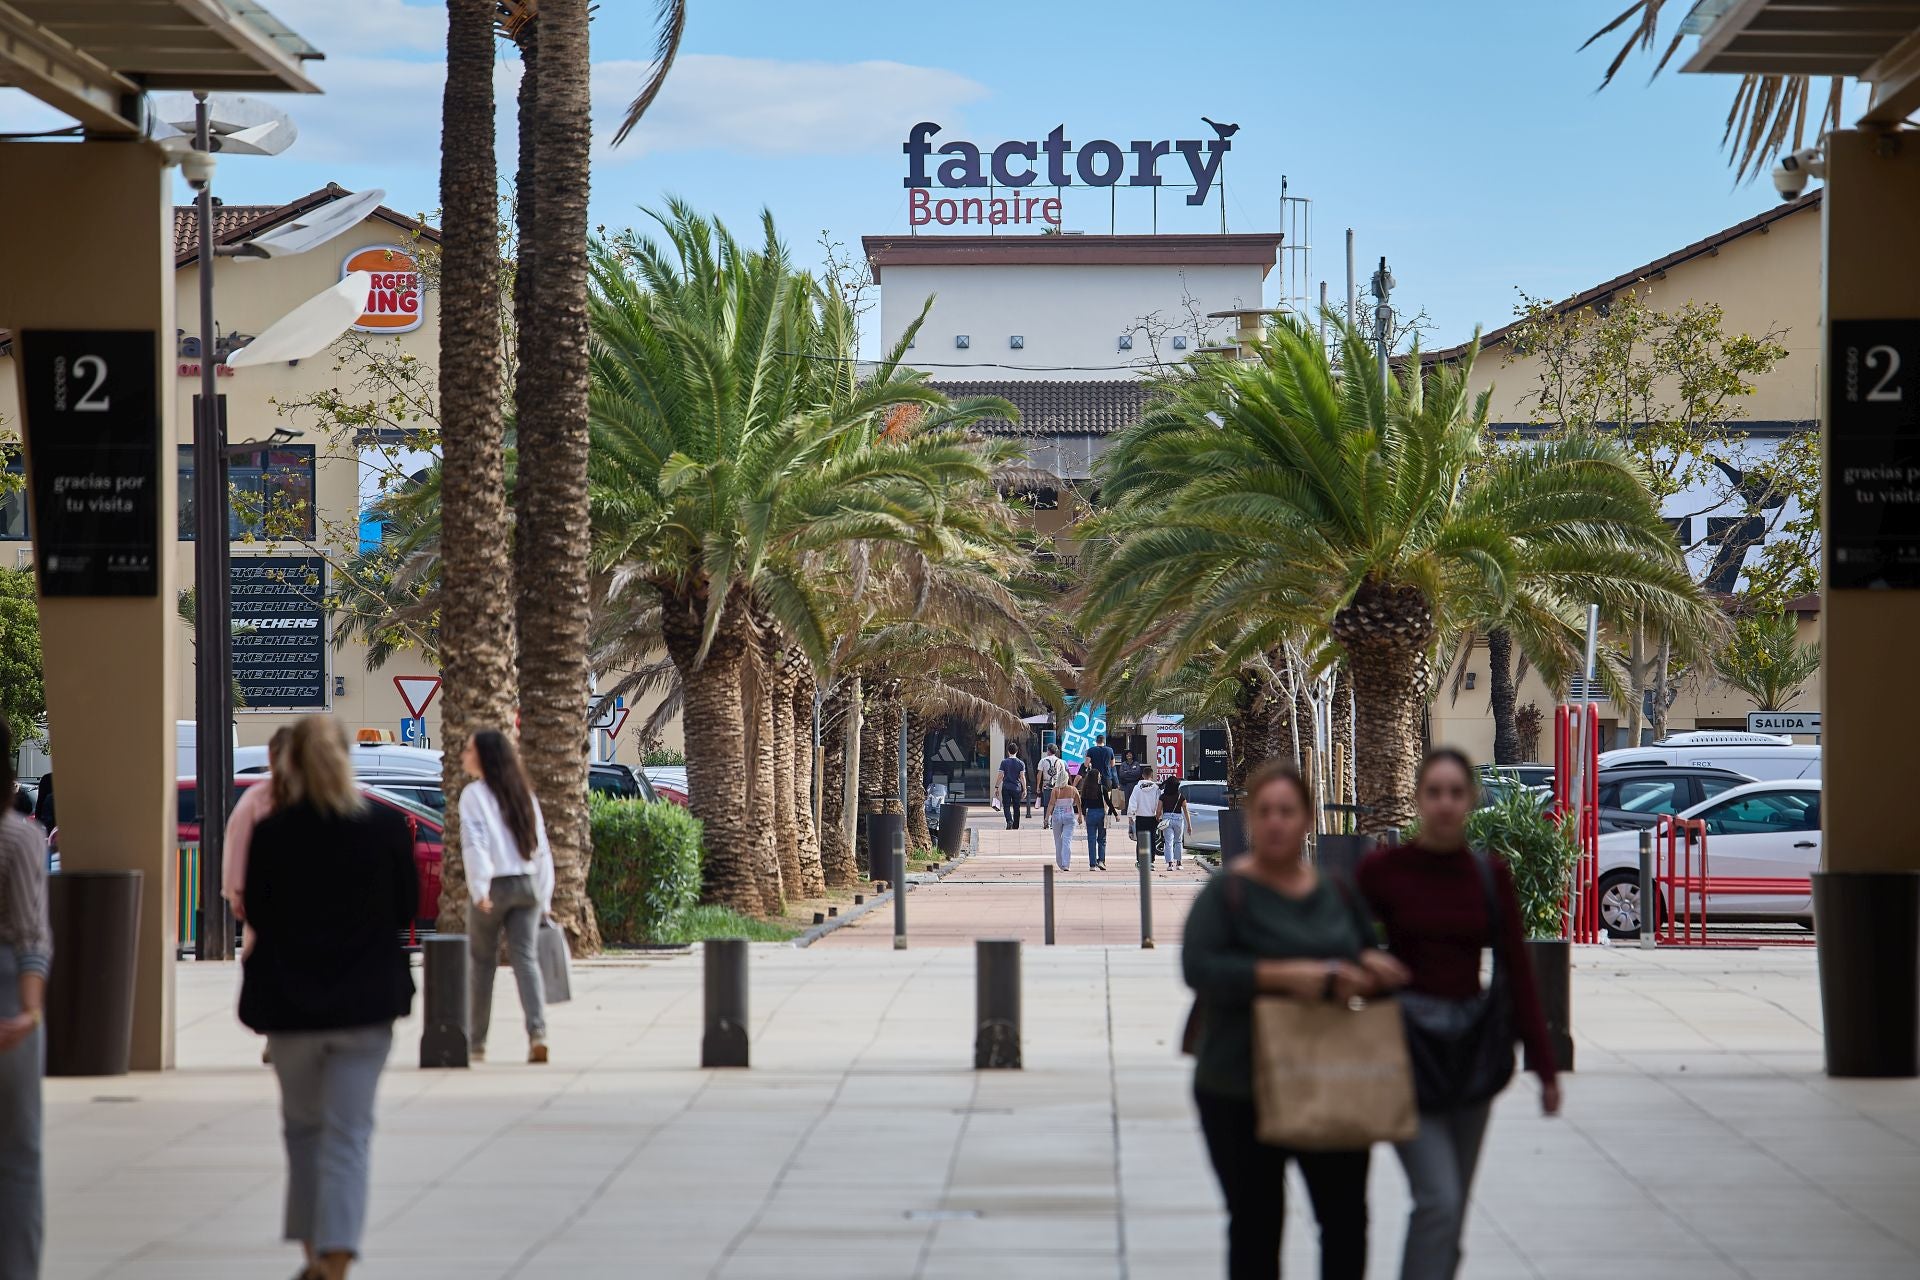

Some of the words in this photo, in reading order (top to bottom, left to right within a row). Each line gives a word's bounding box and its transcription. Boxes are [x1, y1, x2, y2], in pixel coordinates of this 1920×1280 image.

[903, 121, 1232, 206] factory
[909, 188, 1063, 226] Bonaire
[371, 273, 418, 290] RGER
[365, 290, 419, 313] ING
[72, 354, 111, 412] 2
[1865, 344, 1903, 402] 2
[54, 473, 111, 494] gracias
[115, 476, 146, 494] por
[1843, 463, 1903, 485] gracias
[66, 497, 84, 513] tu
[88, 496, 134, 513] visita
[1856, 488, 1874, 504] tu
[241, 686, 319, 697] KECHERS
[1755, 718, 1805, 729] SALIDA
[1205, 748, 1228, 756] Bonair
